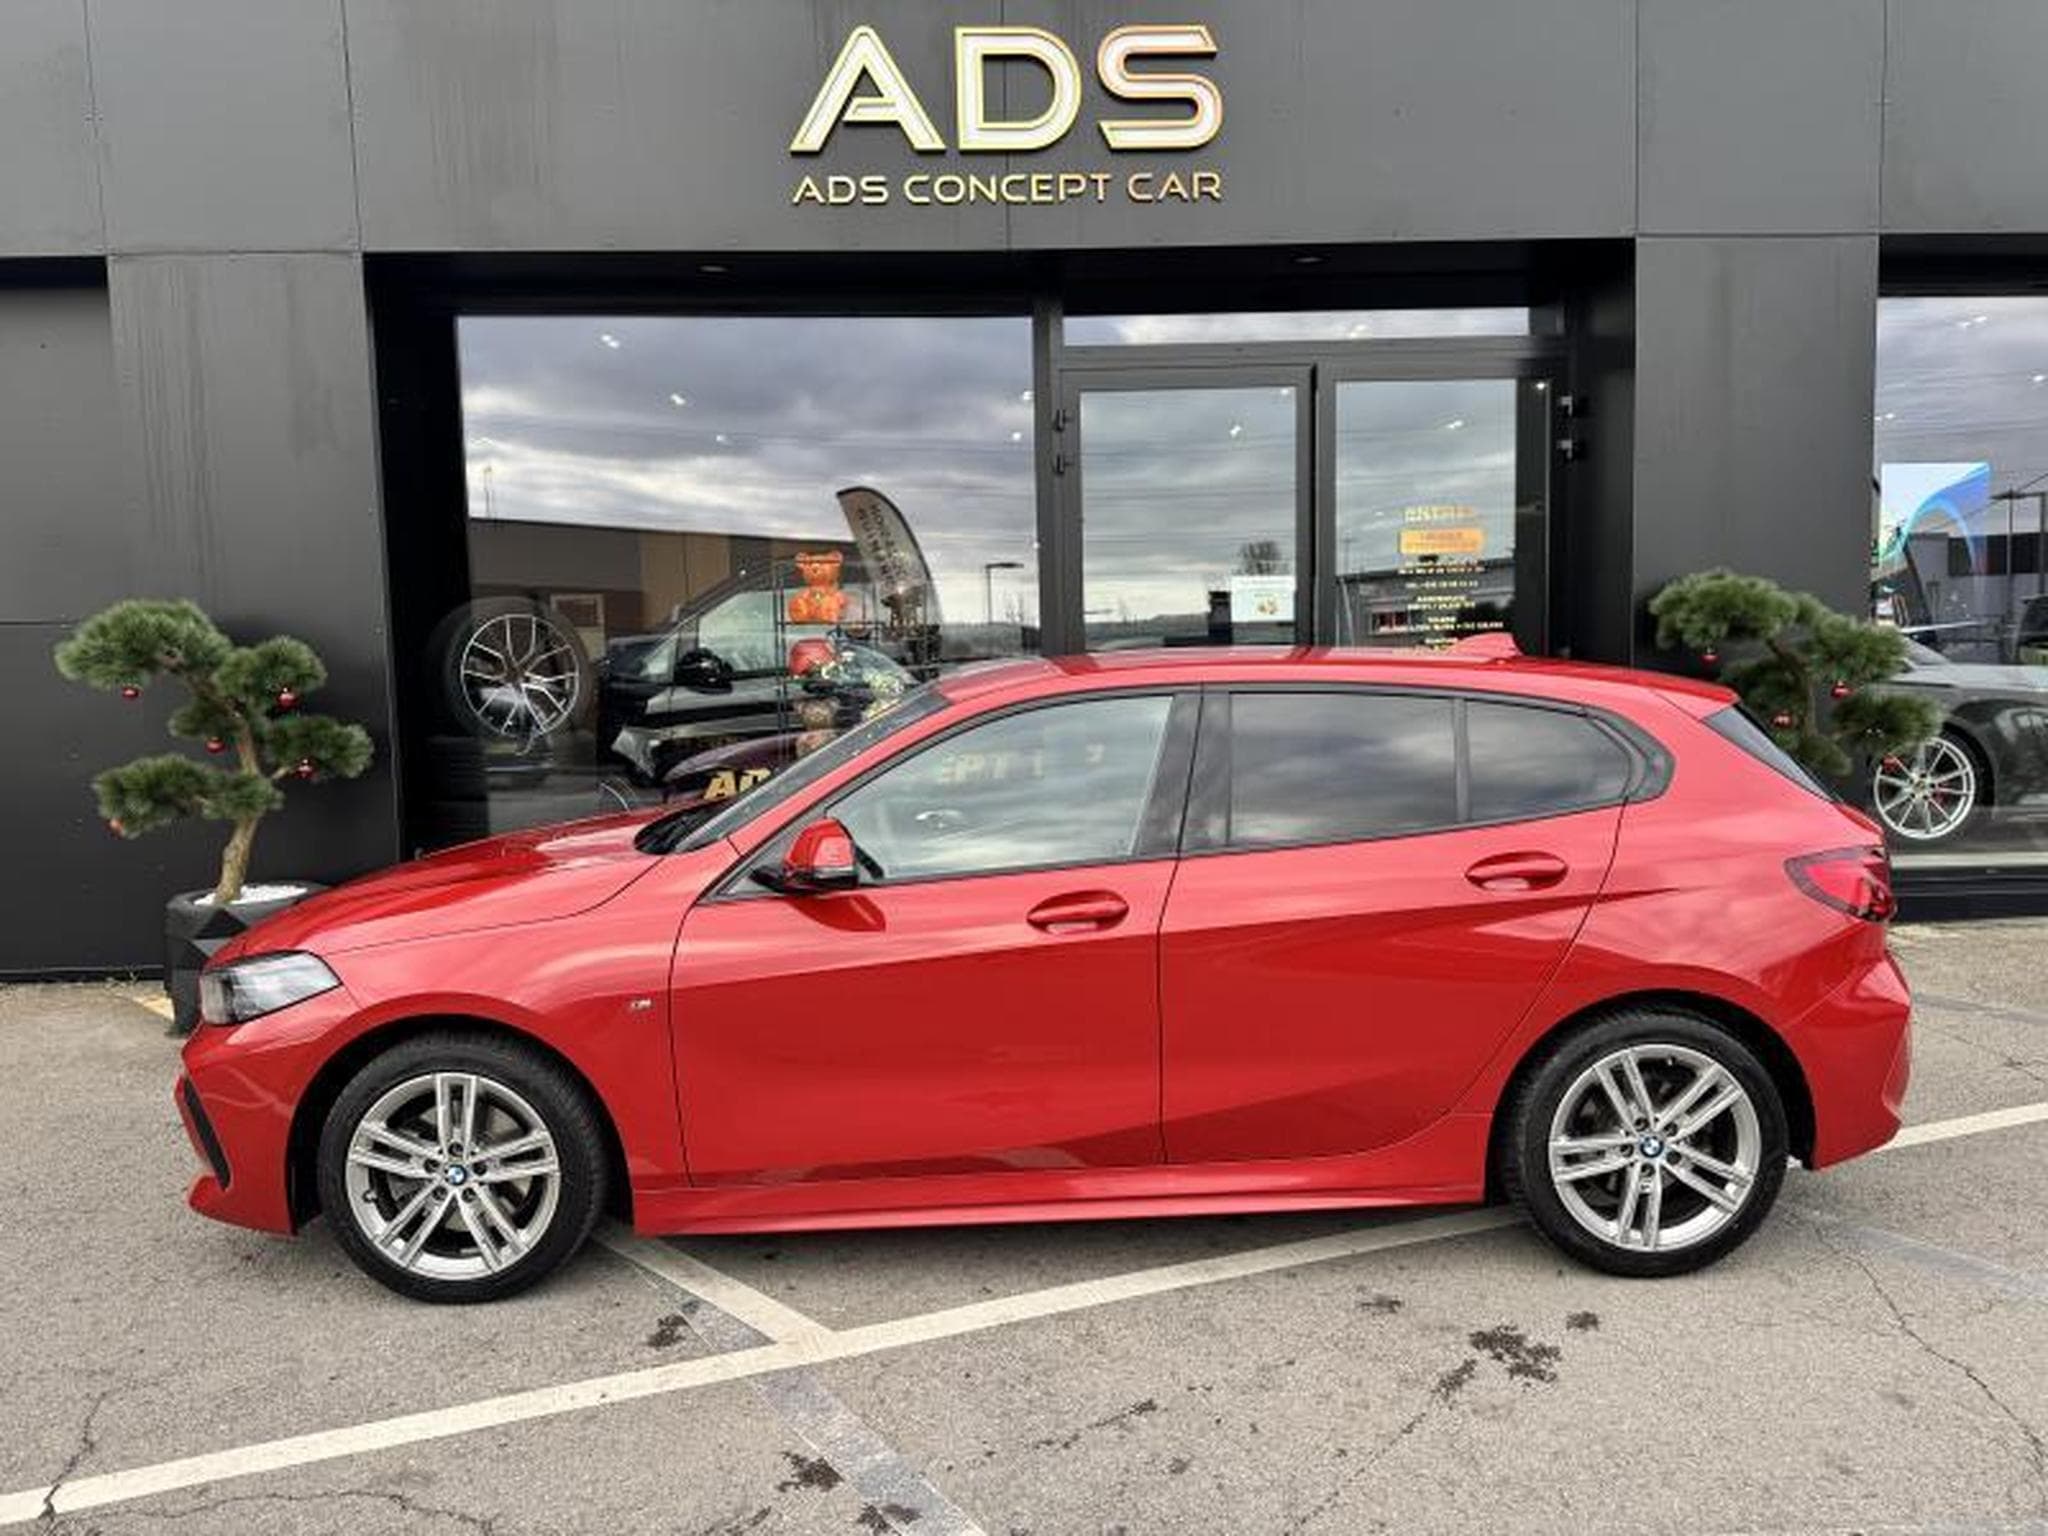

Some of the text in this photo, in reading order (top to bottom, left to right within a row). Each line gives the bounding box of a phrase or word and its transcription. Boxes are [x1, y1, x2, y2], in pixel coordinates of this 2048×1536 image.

[790, 24, 1224, 152] ADS
[792, 171, 1223, 205] ADS CONCEPT CAR
